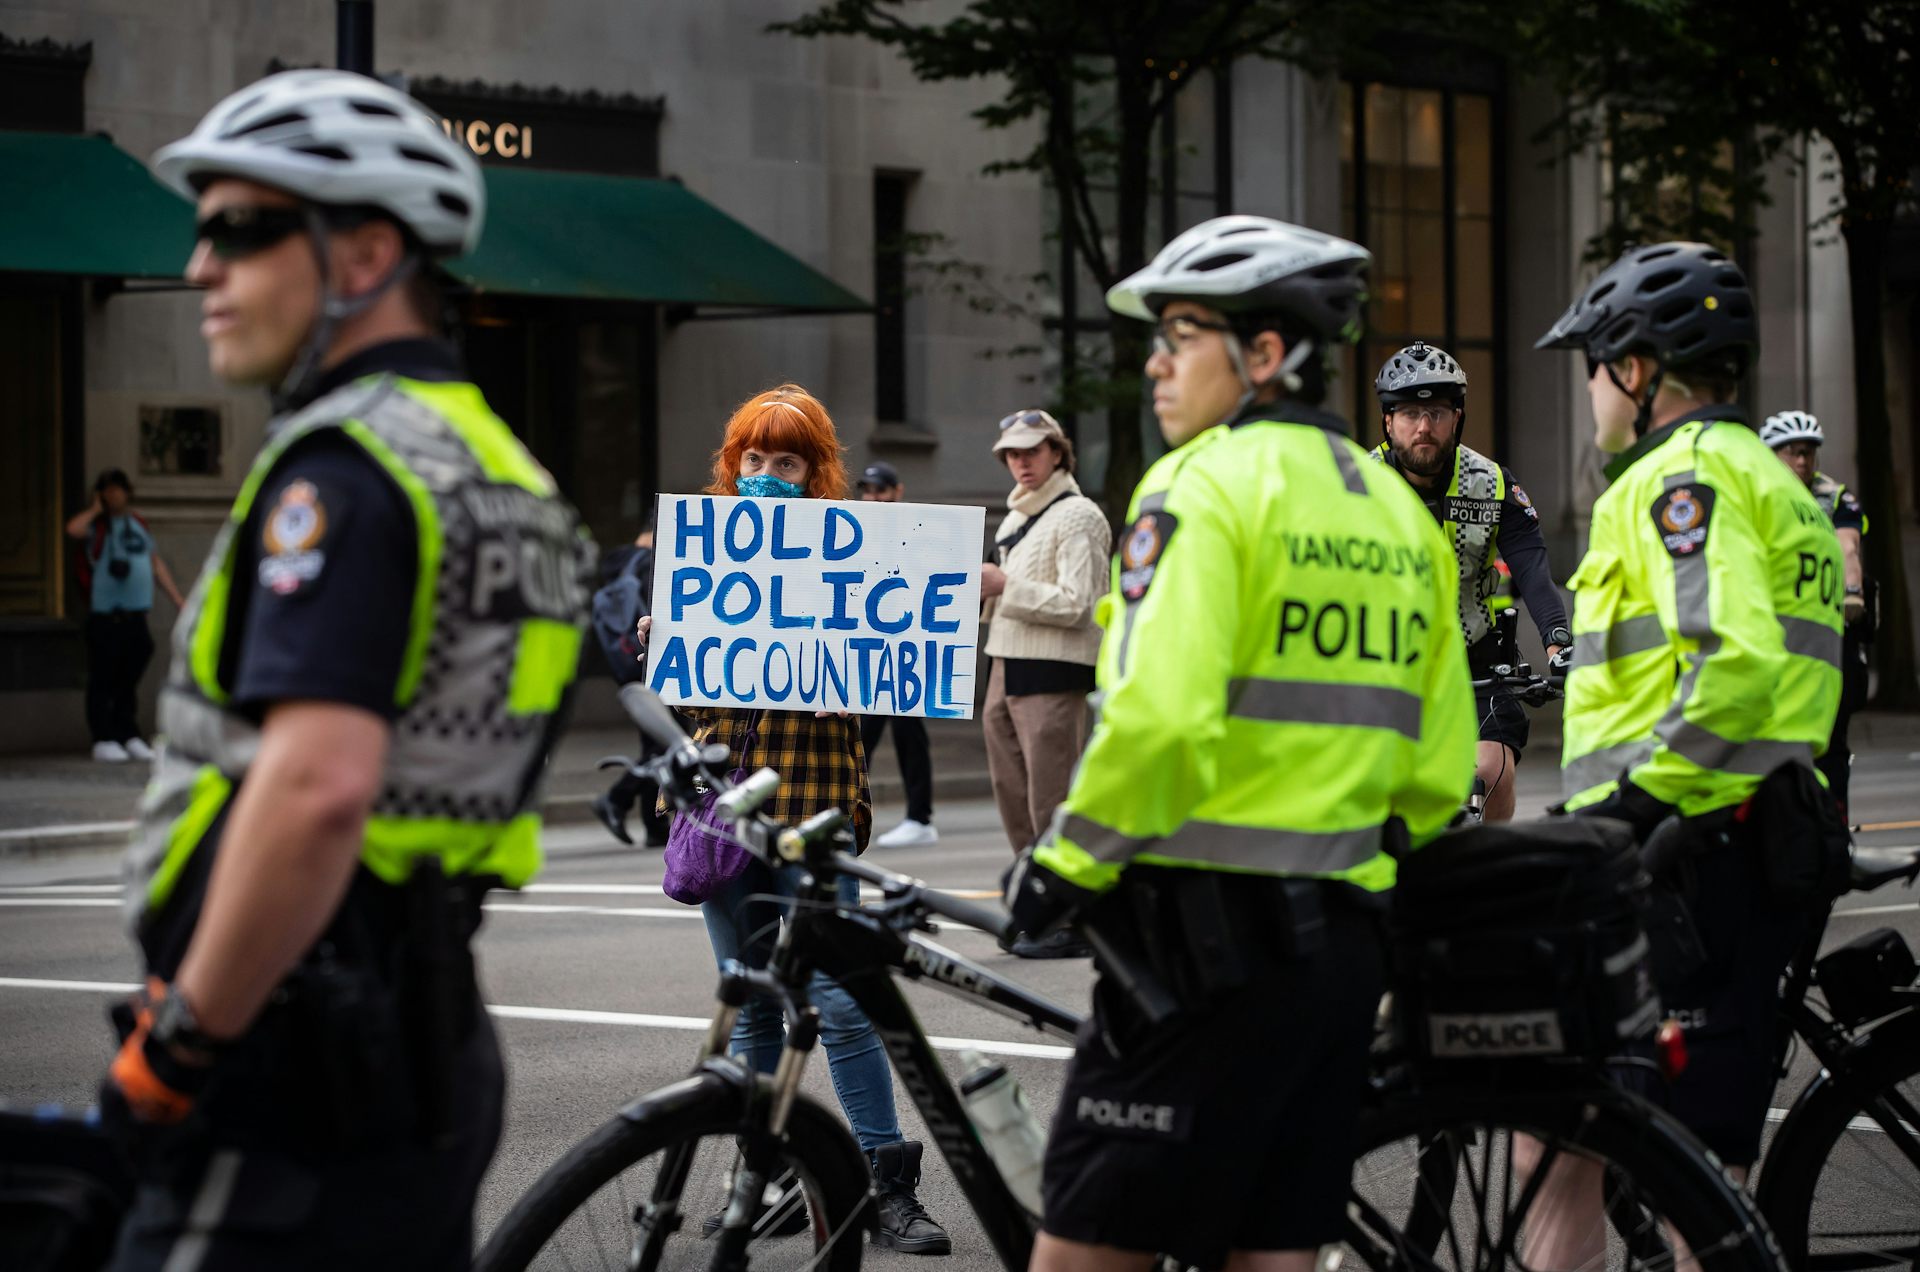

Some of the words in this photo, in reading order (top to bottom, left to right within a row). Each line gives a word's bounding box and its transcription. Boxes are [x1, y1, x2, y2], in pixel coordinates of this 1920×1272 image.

[426, 116, 532, 158] UCCI
[1449, 508, 1501, 523] POLICE
[1450, 500, 1502, 510] VANCOUVER
[675, 498, 864, 565] HOLD
[670, 566, 968, 635] POLICE
[650, 636, 975, 718] ACCOUNTABLE
[903, 944, 993, 994] POLICE
[1444, 1021, 1550, 1048] POLICE
[1077, 1096, 1174, 1132] POLICE
